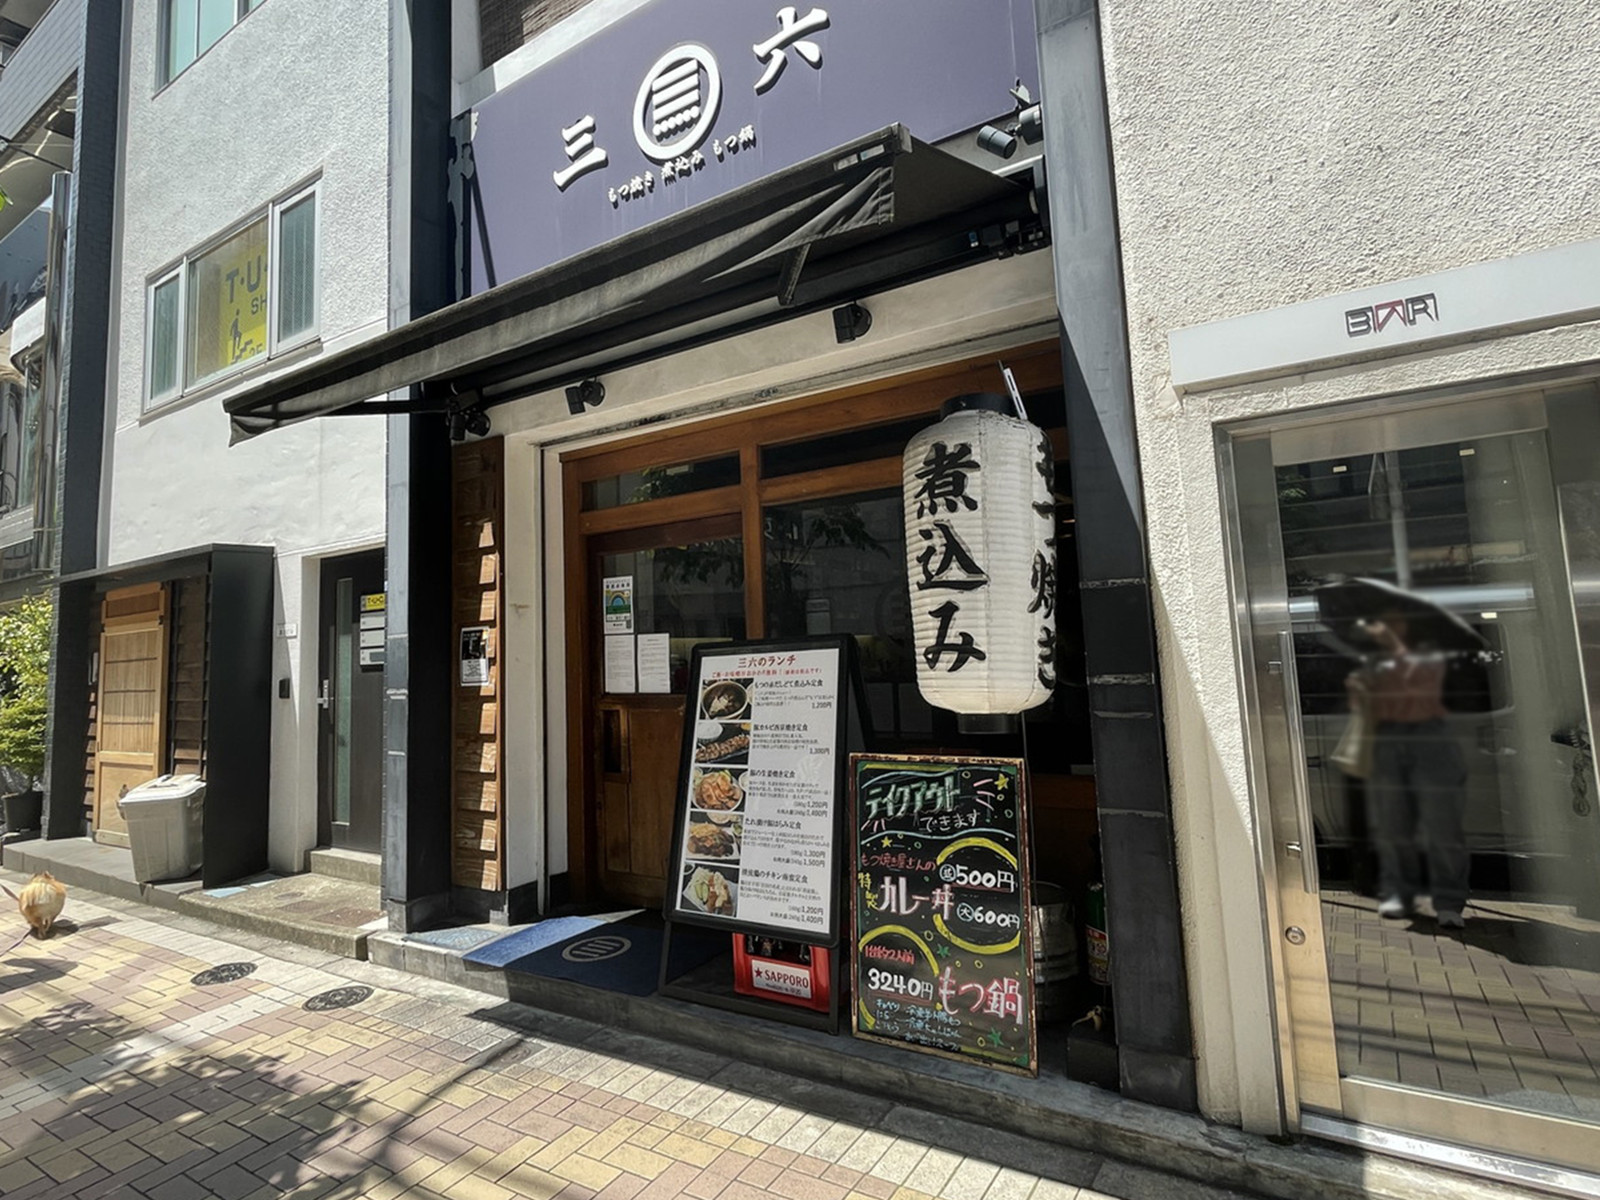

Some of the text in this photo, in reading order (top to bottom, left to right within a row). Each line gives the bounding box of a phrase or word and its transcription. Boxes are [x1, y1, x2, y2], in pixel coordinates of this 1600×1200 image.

[552, 7, 830, 190] 三 六
[607, 124, 755, 204] もつ焼き 煮込み もつ鍋
[1344, 292, 1440, 338] BAR
[914, 440, 991, 673] 煮込み
[738, 654, 797, 669] 三六のランチ
[920, 809, 981, 833] できます
[879, 875, 955, 920] カレー丼
[764, 969, 809, 989] SAPPORO
[867, 967, 934, 1001] 3240円
[937, 965, 1023, 1025] もつ鍋
